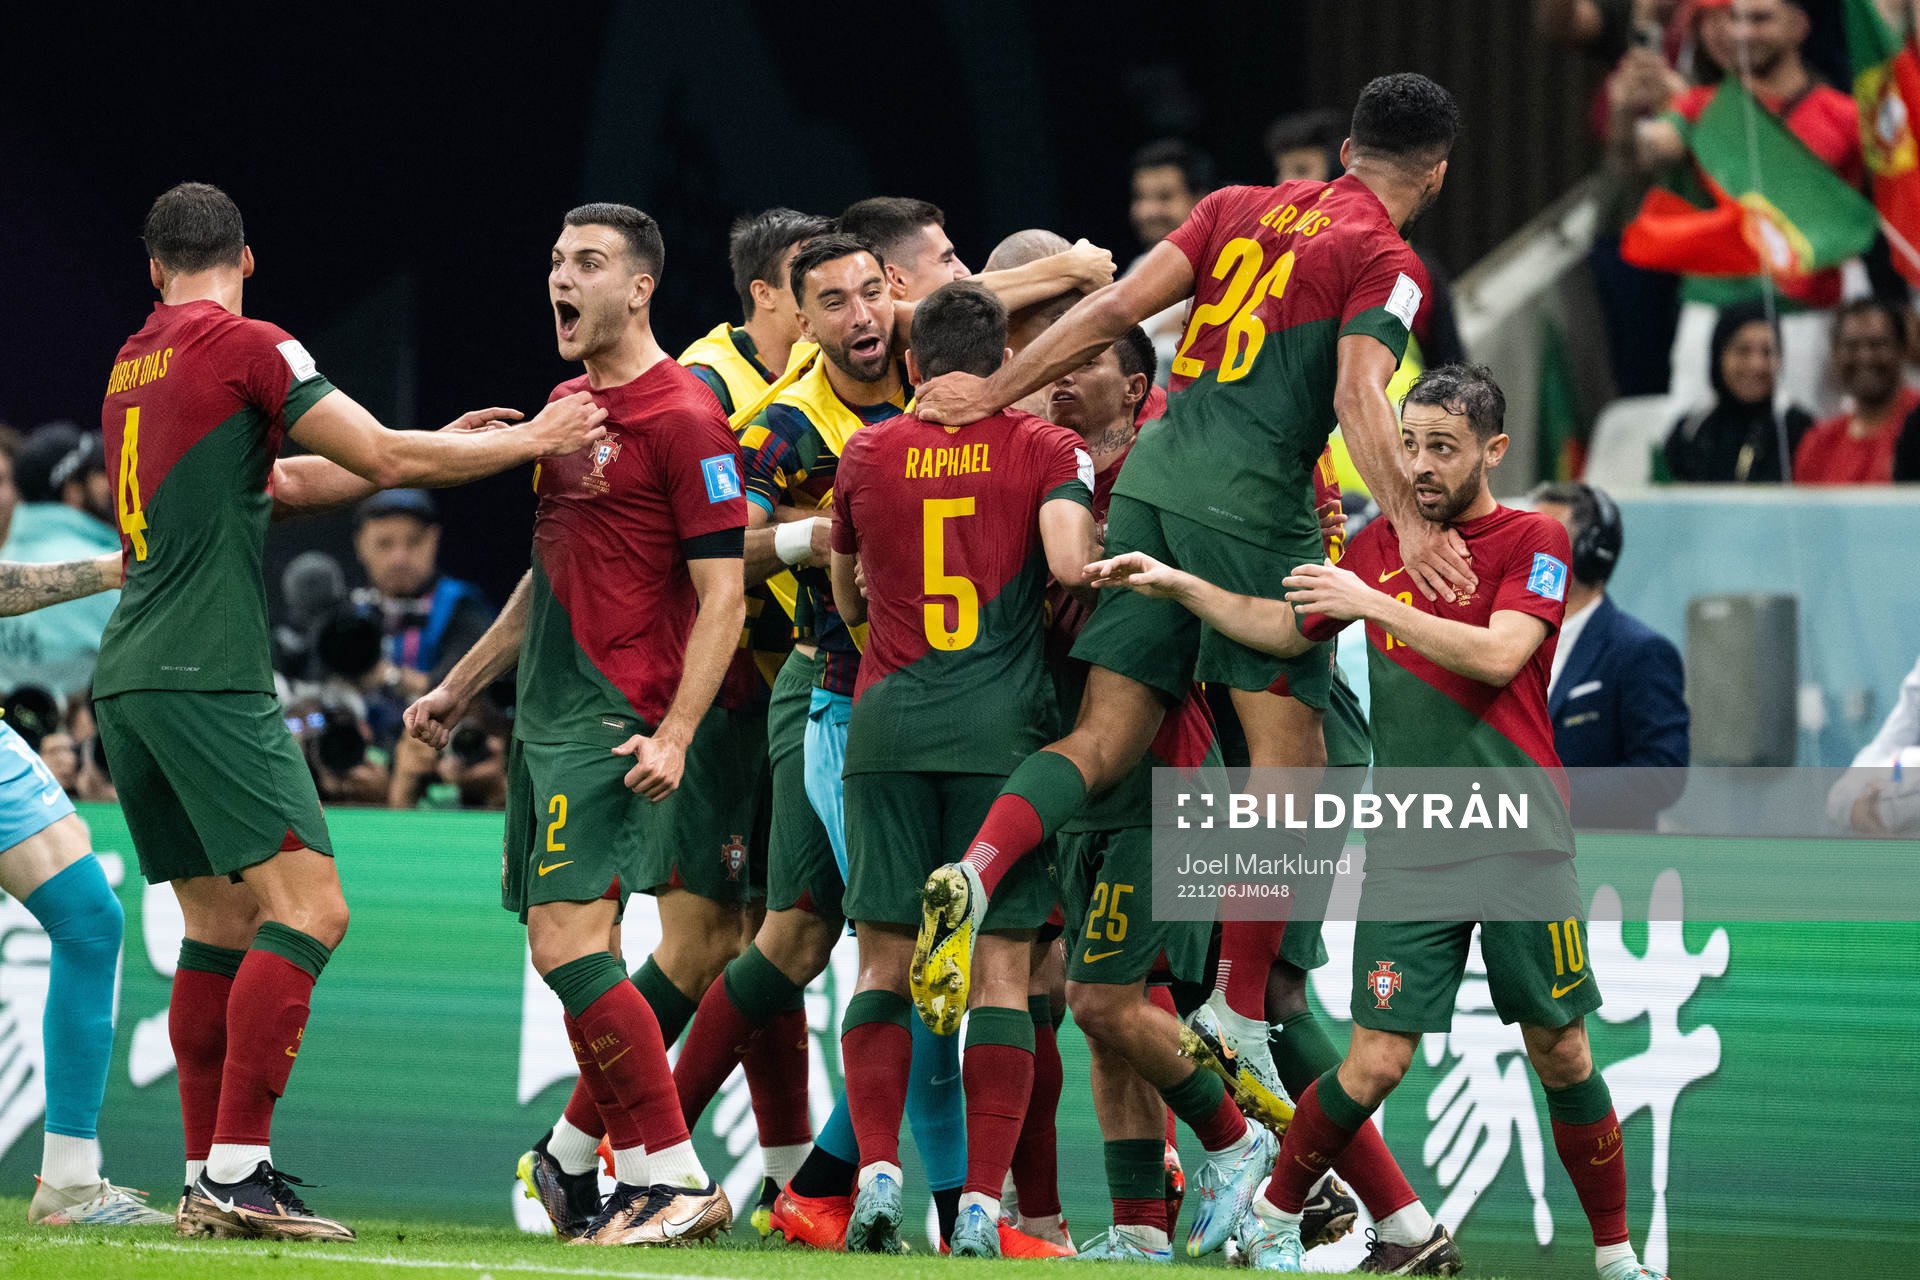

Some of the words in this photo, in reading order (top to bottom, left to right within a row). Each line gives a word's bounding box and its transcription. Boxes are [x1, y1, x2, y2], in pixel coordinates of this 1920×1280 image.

[1171, 237, 1296, 383] 26
[139, 347, 174, 386] DIAS
[118, 406, 149, 562] 4
[904, 443, 992, 479] RAPHAEL
[923, 496, 979, 652] 5
[546, 793, 568, 852] 2
[1086, 881, 1134, 942] 25
[1547, 915, 1584, 976] 10
